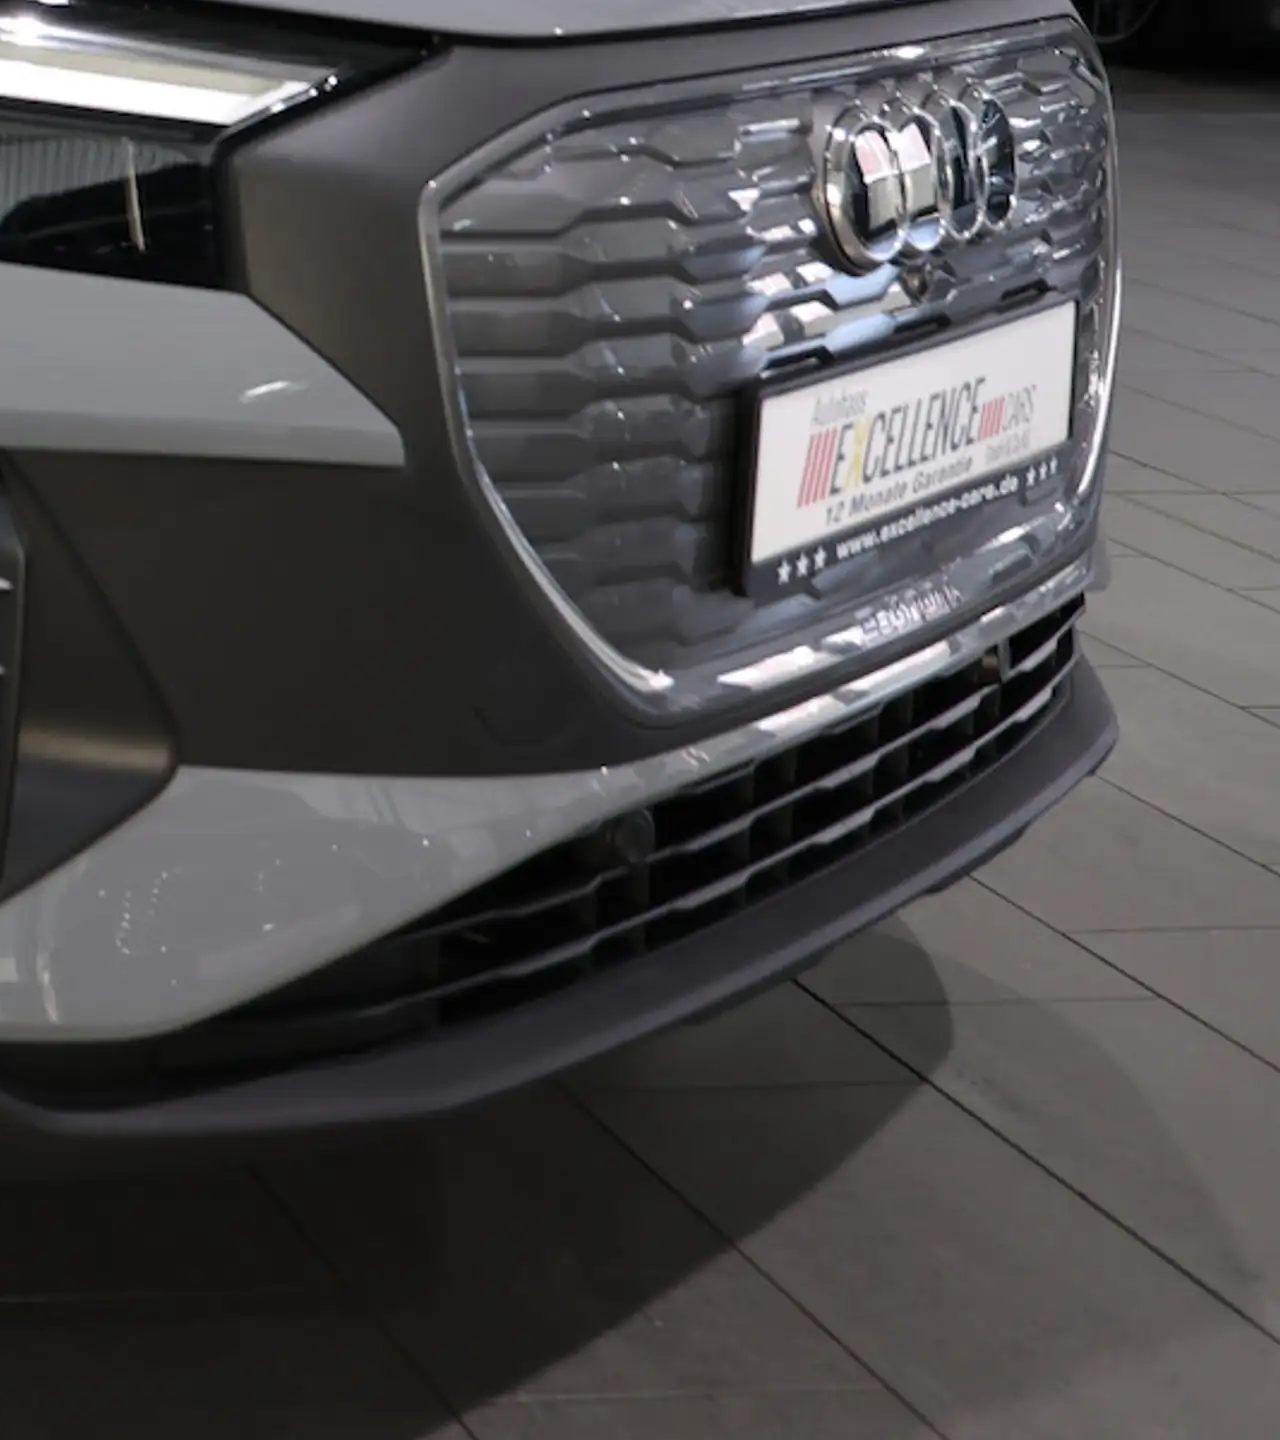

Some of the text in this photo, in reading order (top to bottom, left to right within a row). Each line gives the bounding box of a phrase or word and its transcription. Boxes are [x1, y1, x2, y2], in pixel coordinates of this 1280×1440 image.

[829, 376, 986, 496] EXCELLENCE
[826, 501, 846, 526] 12
[848, 480, 908, 517] Monate
